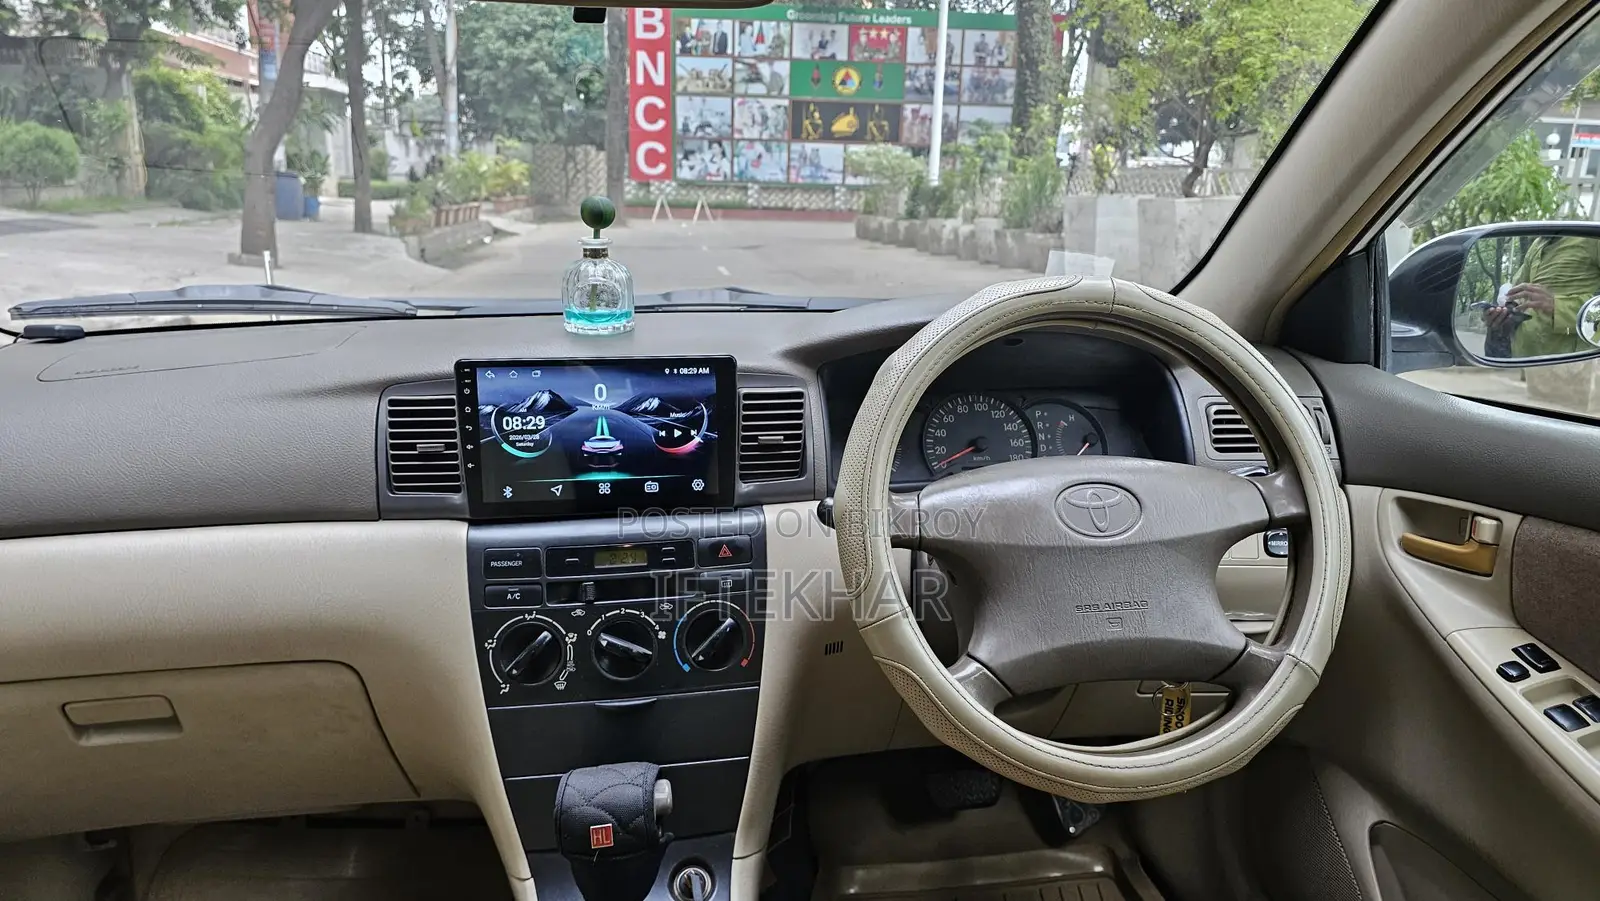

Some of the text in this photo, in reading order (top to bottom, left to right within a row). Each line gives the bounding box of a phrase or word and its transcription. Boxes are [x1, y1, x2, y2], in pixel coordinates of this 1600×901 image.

[838, 11, 871, 23] Future
[872, 13, 912, 25] Leaders
[634, 7, 667, 176] BNCC
[679, 367, 697, 375] 08:29
[594, 383, 607, 401] 0
[957, 404, 969, 413] 80
[974, 402, 989, 411] 100
[942, 414, 955, 423] 60
[991, 410, 1006, 419] 120
[1035, 410, 1042, 419] P
[502, 415, 546, 431] 08:29
[1003, 422, 1019, 432] 140
[1037, 421, 1044, 430] R
[934, 428, 947, 437] 40
[1038, 432, 1045, 441] N
[1009, 438, 1025, 447] 160
[934, 445, 947, 455] 20
[1040, 444, 1047, 452] D
[620, 607, 626, 615] 2
[1075, 600, 1149, 613] SRS AIRBAG
[593, 829, 611, 845] HL
